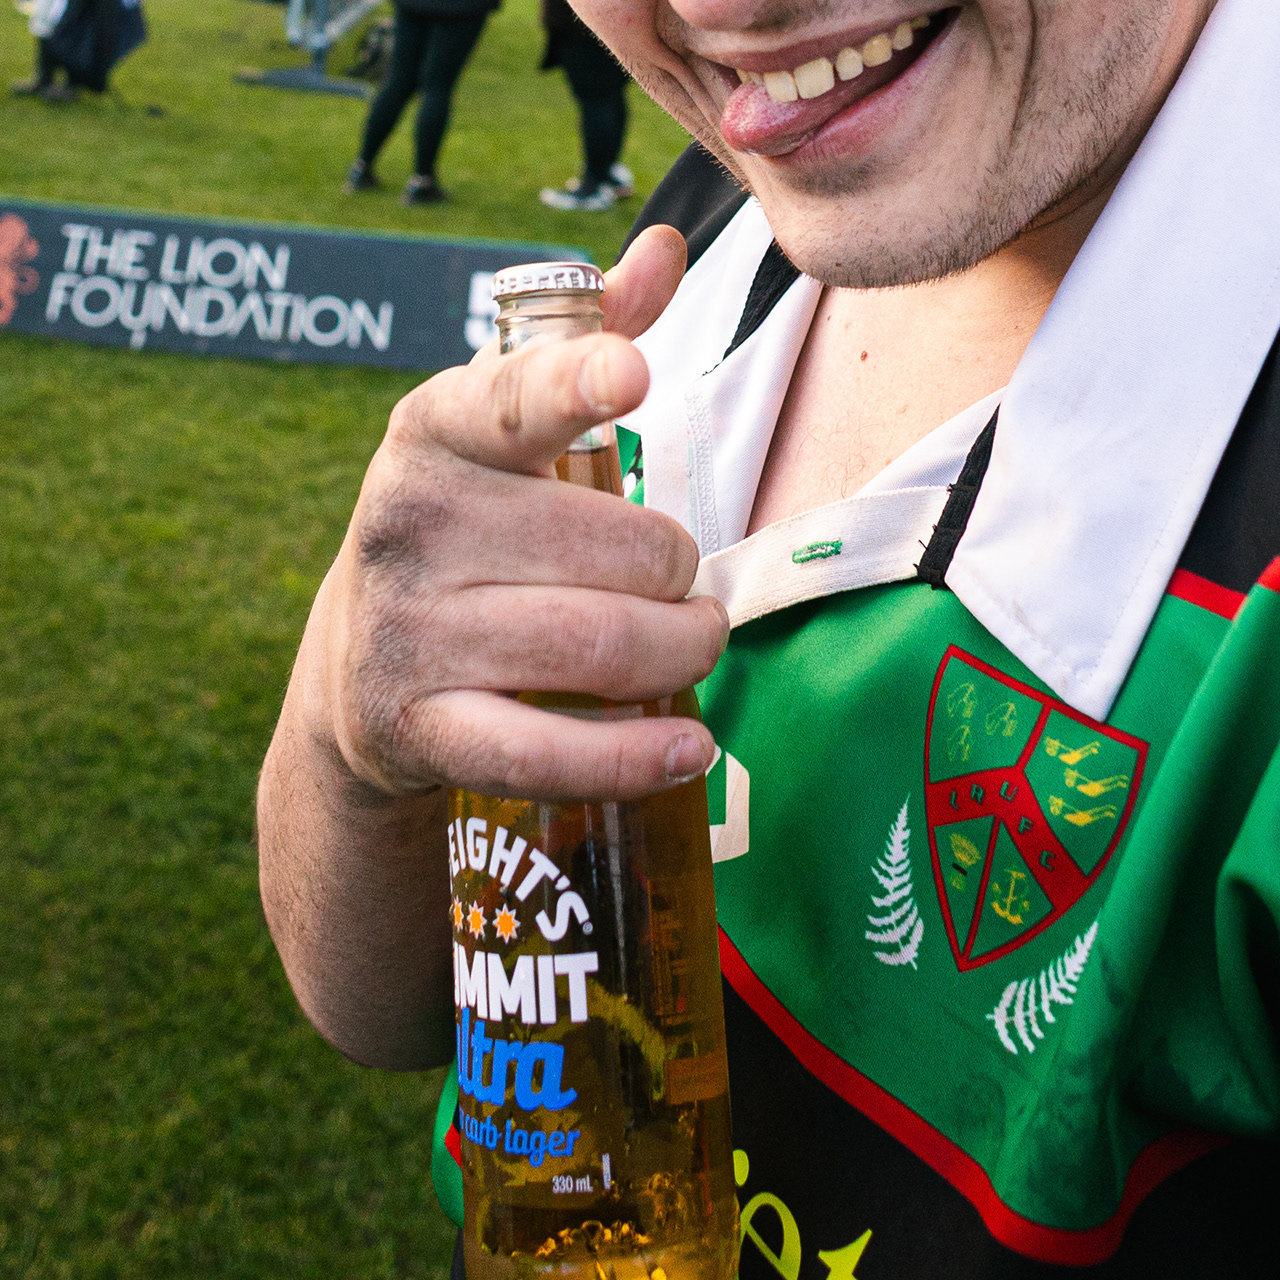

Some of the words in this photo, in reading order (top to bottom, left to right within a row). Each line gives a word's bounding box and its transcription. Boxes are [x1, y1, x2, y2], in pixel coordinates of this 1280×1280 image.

[62, 224, 156, 278] THE
[160, 233, 289, 291] LION
[46, 274, 393, 352] FOUNDATION
[447, 816, 591, 942] EIGHT'S
[456, 1007, 578, 1111] ltra
[465, 1115, 502, 1150] carb
[505, 1119, 580, 1167] lager
[552, 1176, 573, 1193] 330
[576, 1175, 594, 1192] mL
